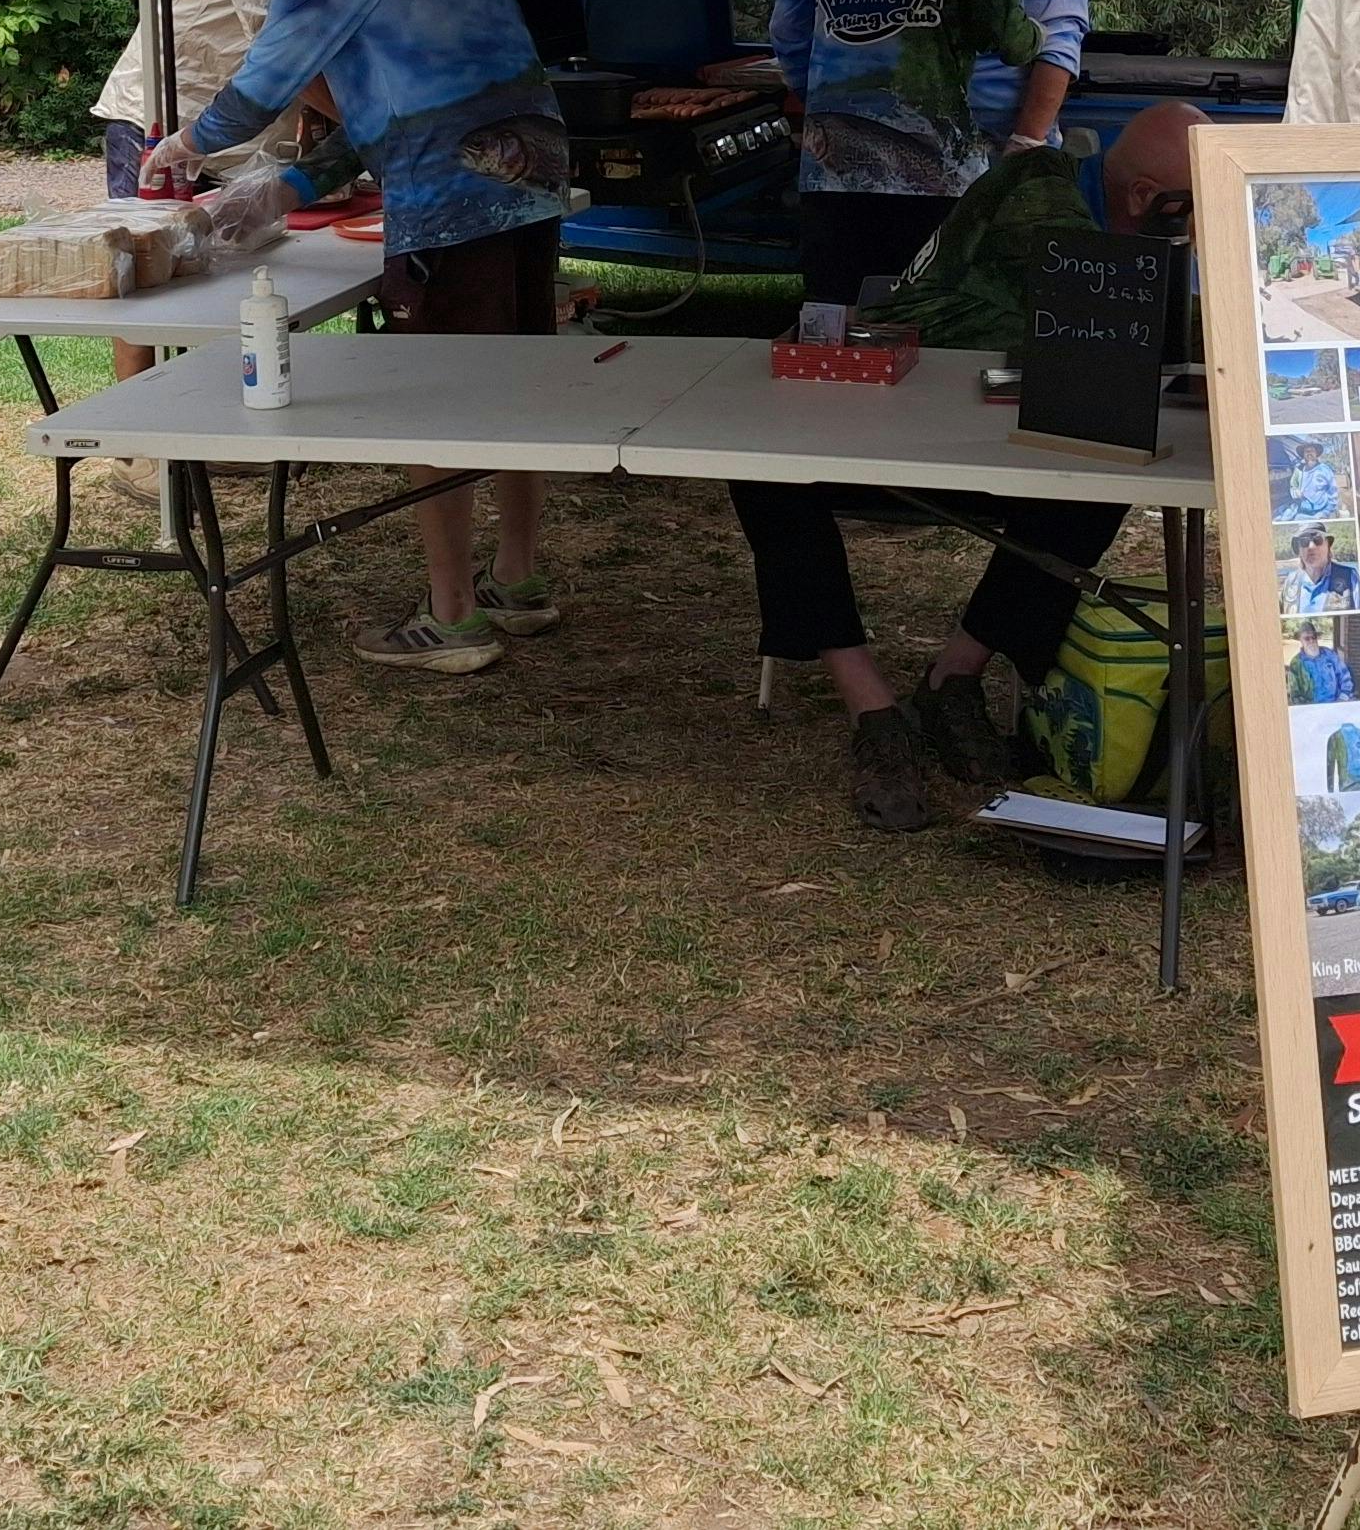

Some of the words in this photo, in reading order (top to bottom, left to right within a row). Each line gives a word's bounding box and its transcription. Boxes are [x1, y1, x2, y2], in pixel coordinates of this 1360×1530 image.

[892, 8, 938, 24] Club
[1041, 240, 1117, 294] Snags
[1135, 255, 1158, 281] $3
[1034, 309, 1117, 340] Drinks
[1129, 321, 1150, 346] $2
[1312, 960, 1341, 980] King
